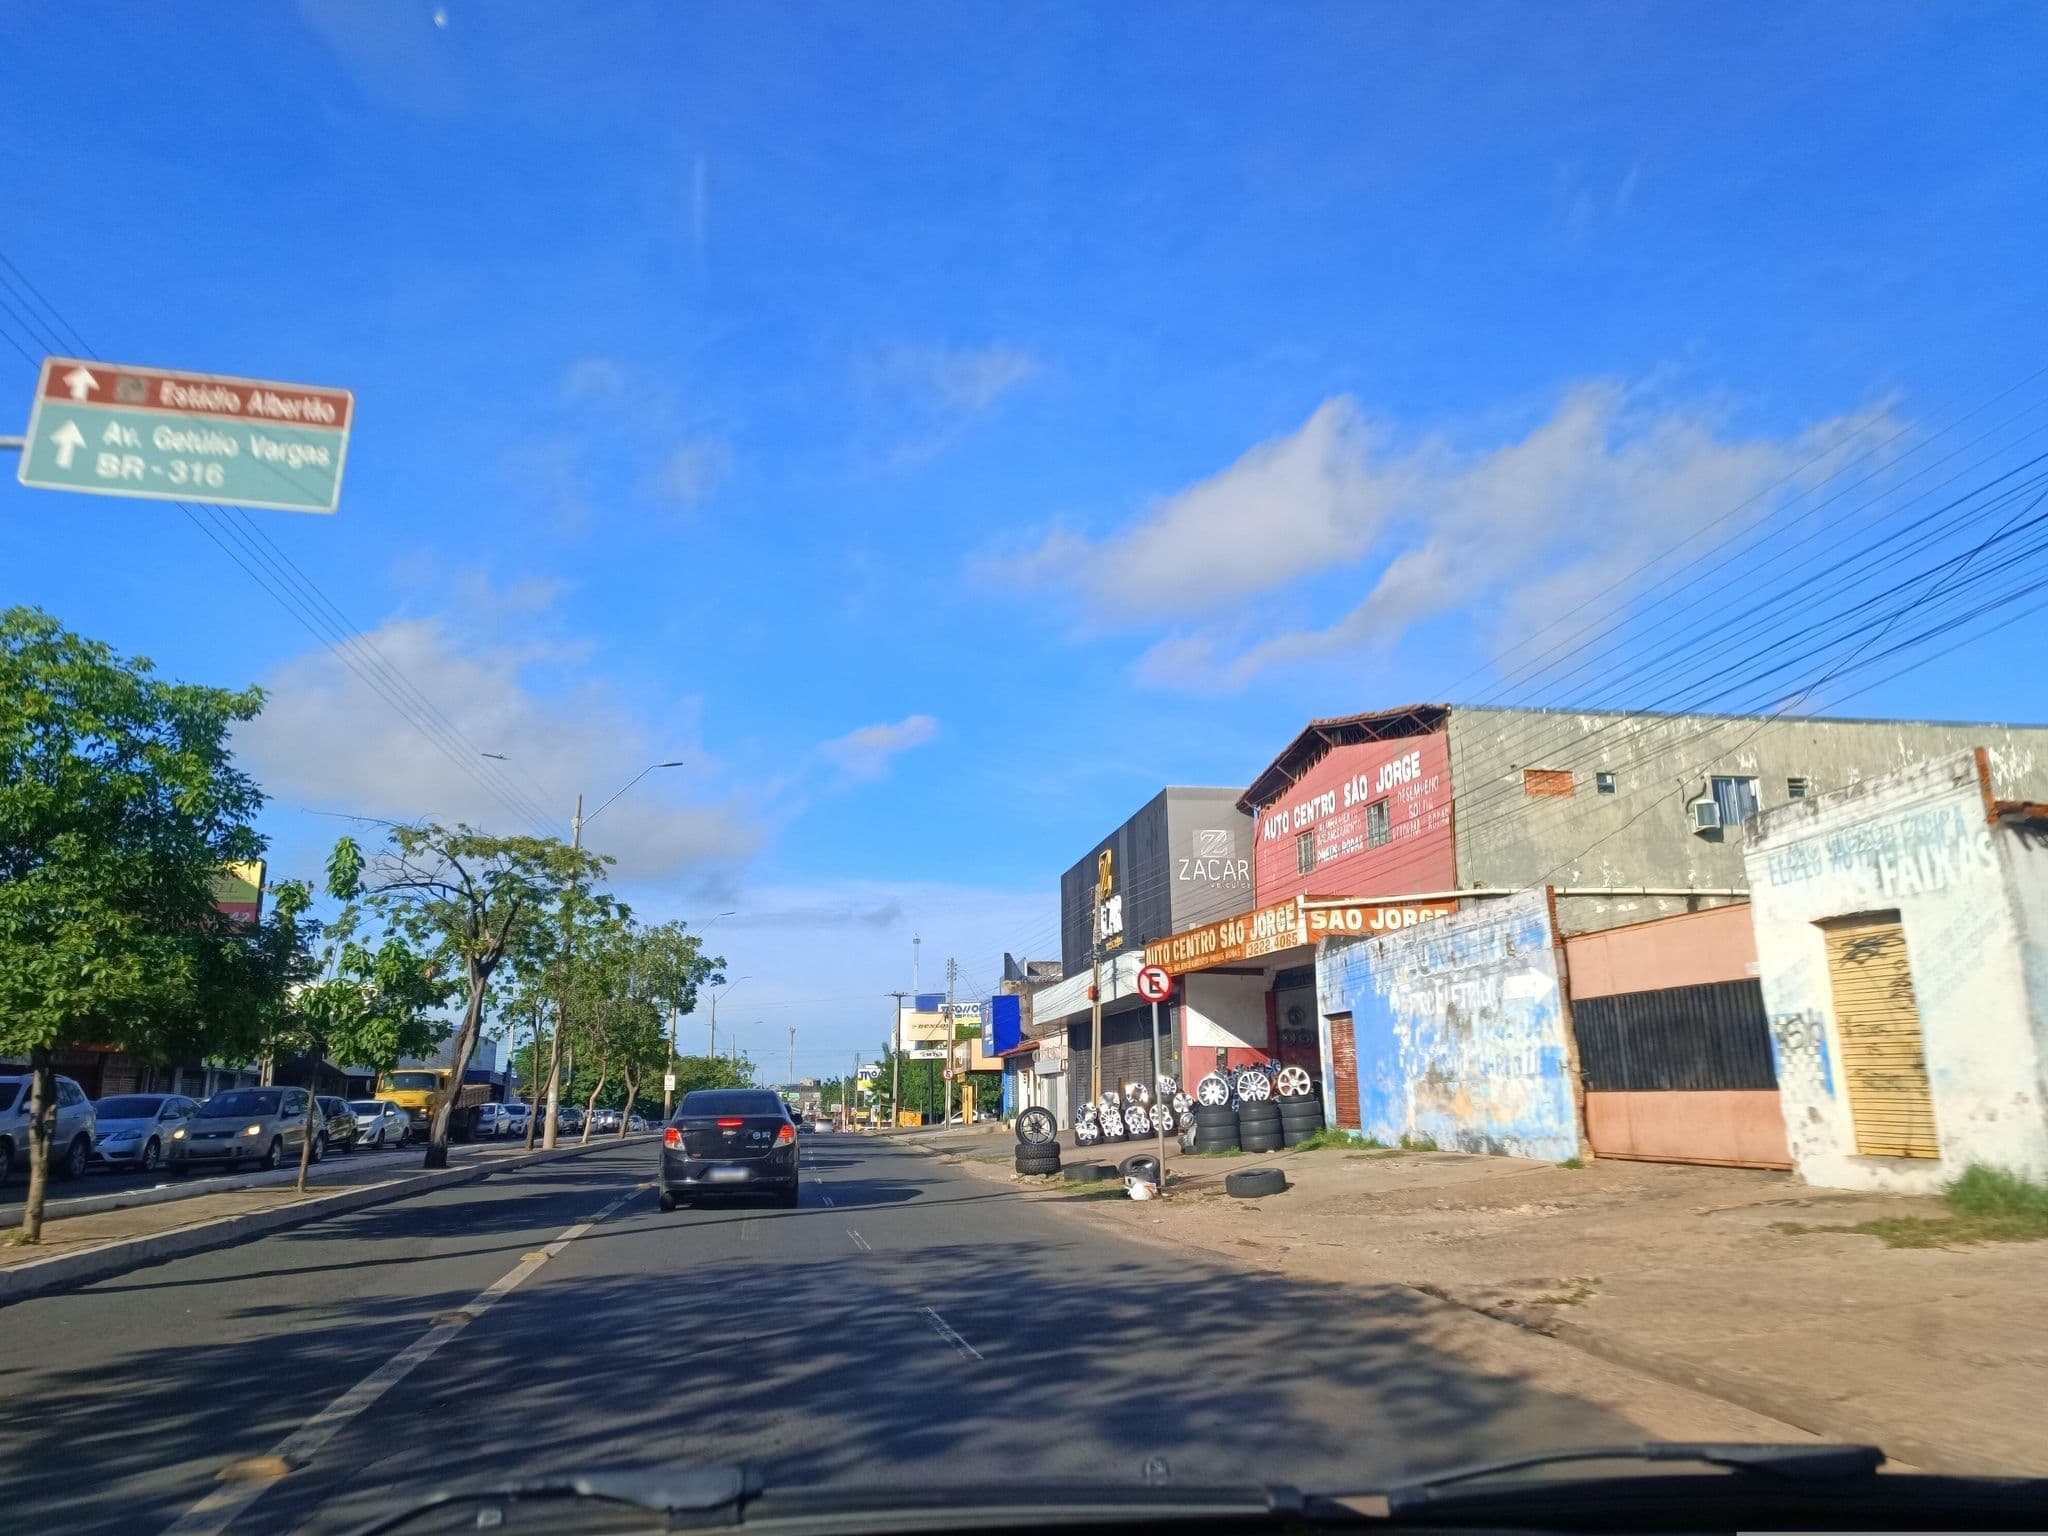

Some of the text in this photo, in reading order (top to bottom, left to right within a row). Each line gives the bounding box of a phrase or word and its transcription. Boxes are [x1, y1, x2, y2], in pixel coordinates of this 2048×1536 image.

[249, 434, 331, 470] Vargas
[1263, 750, 1421, 841] AUTO CENTRO SÃO JORGE
[1178, 858, 1250, 881] ZACAR
[1878, 831, 1999, 899] FAIXAS
[1146, 943, 1170, 965] AUTO
[1173, 929, 1216, 961] CENTRO
[1219, 917, 1244, 949] SÃO
[1250, 903, 1296, 941] JORGE
